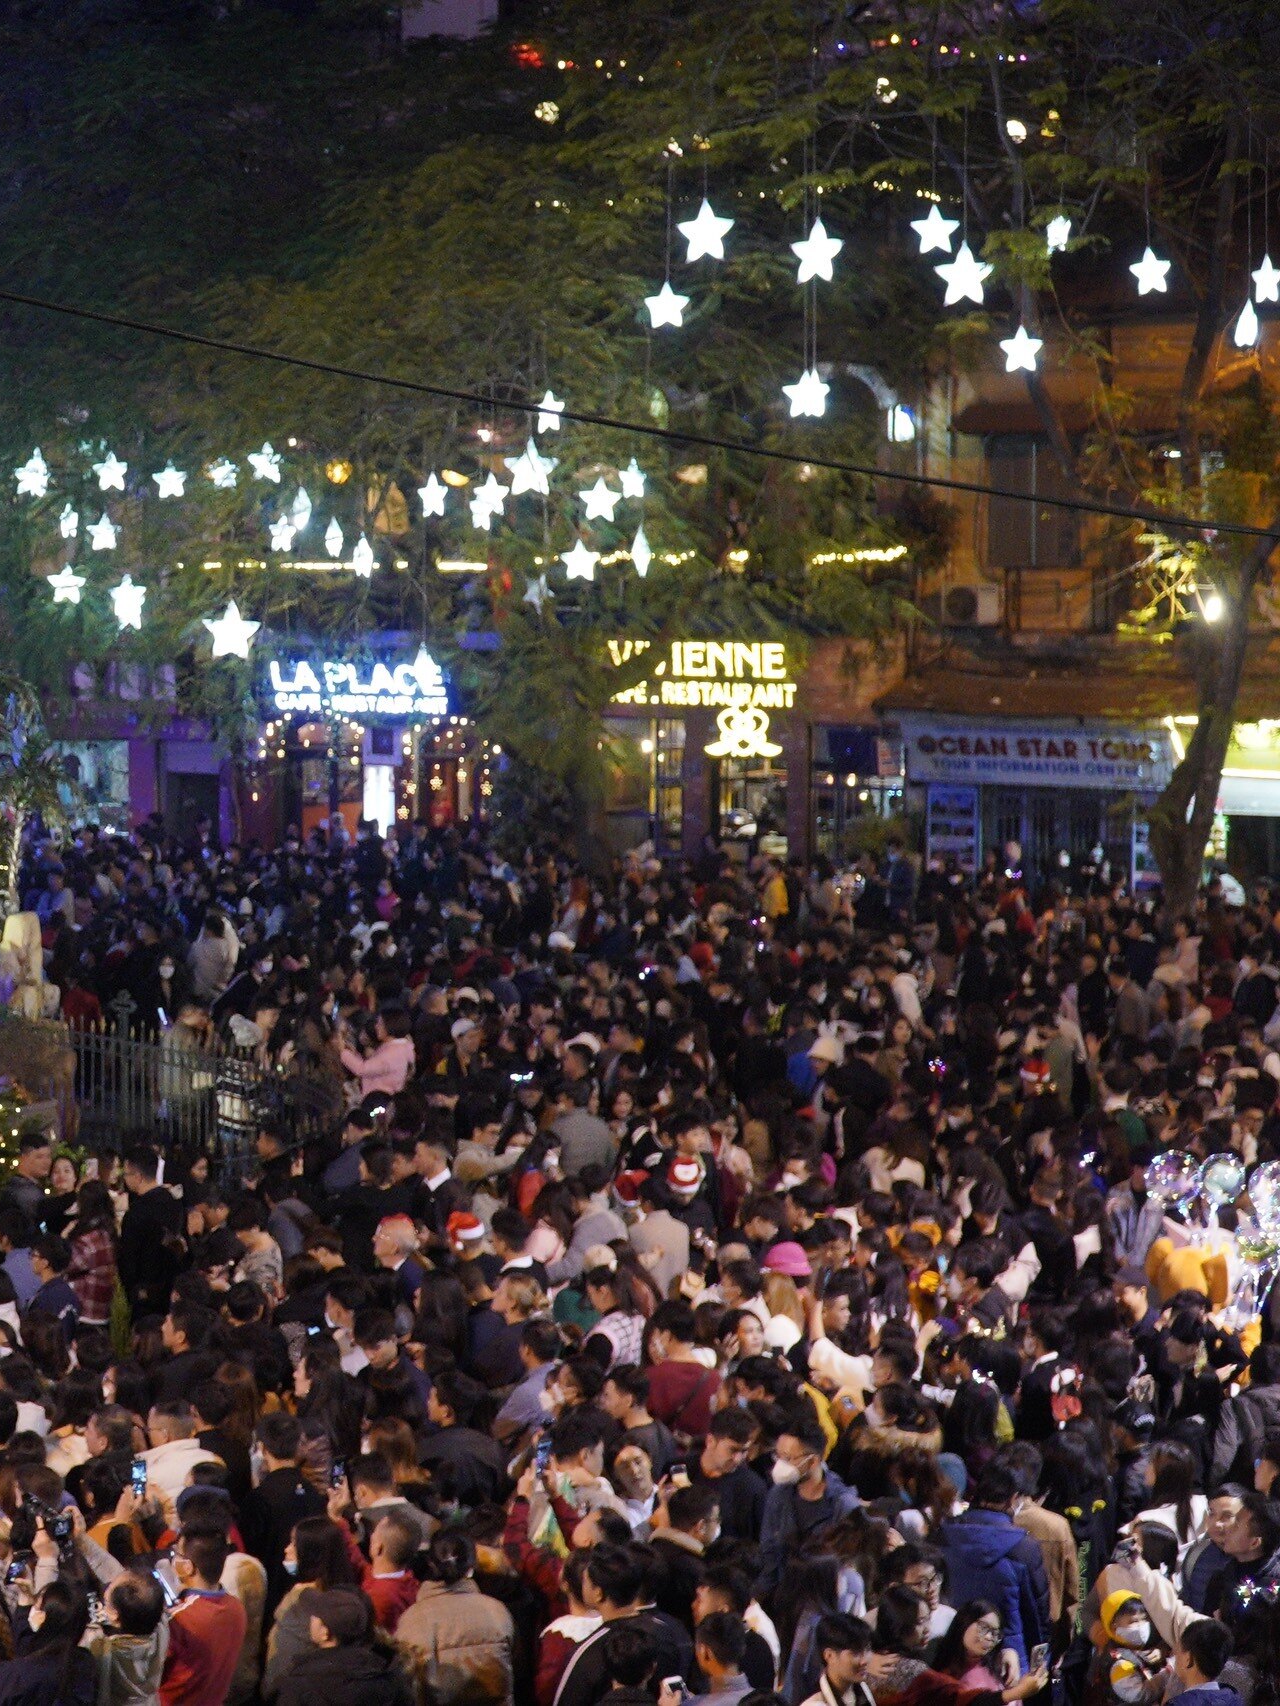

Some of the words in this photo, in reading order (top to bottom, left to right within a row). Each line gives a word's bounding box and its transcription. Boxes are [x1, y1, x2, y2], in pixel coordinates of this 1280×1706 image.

[607, 640, 787, 679] VIENNE
[270, 661, 320, 692] LA
[323, 662, 446, 696] PLACE
[660, 680, 797, 708] RESTAURANT
[918, 734, 1007, 756] OCEAN
[1017, 736, 1078, 758] STAR
[976, 758, 1080, 776] INFORMATION
